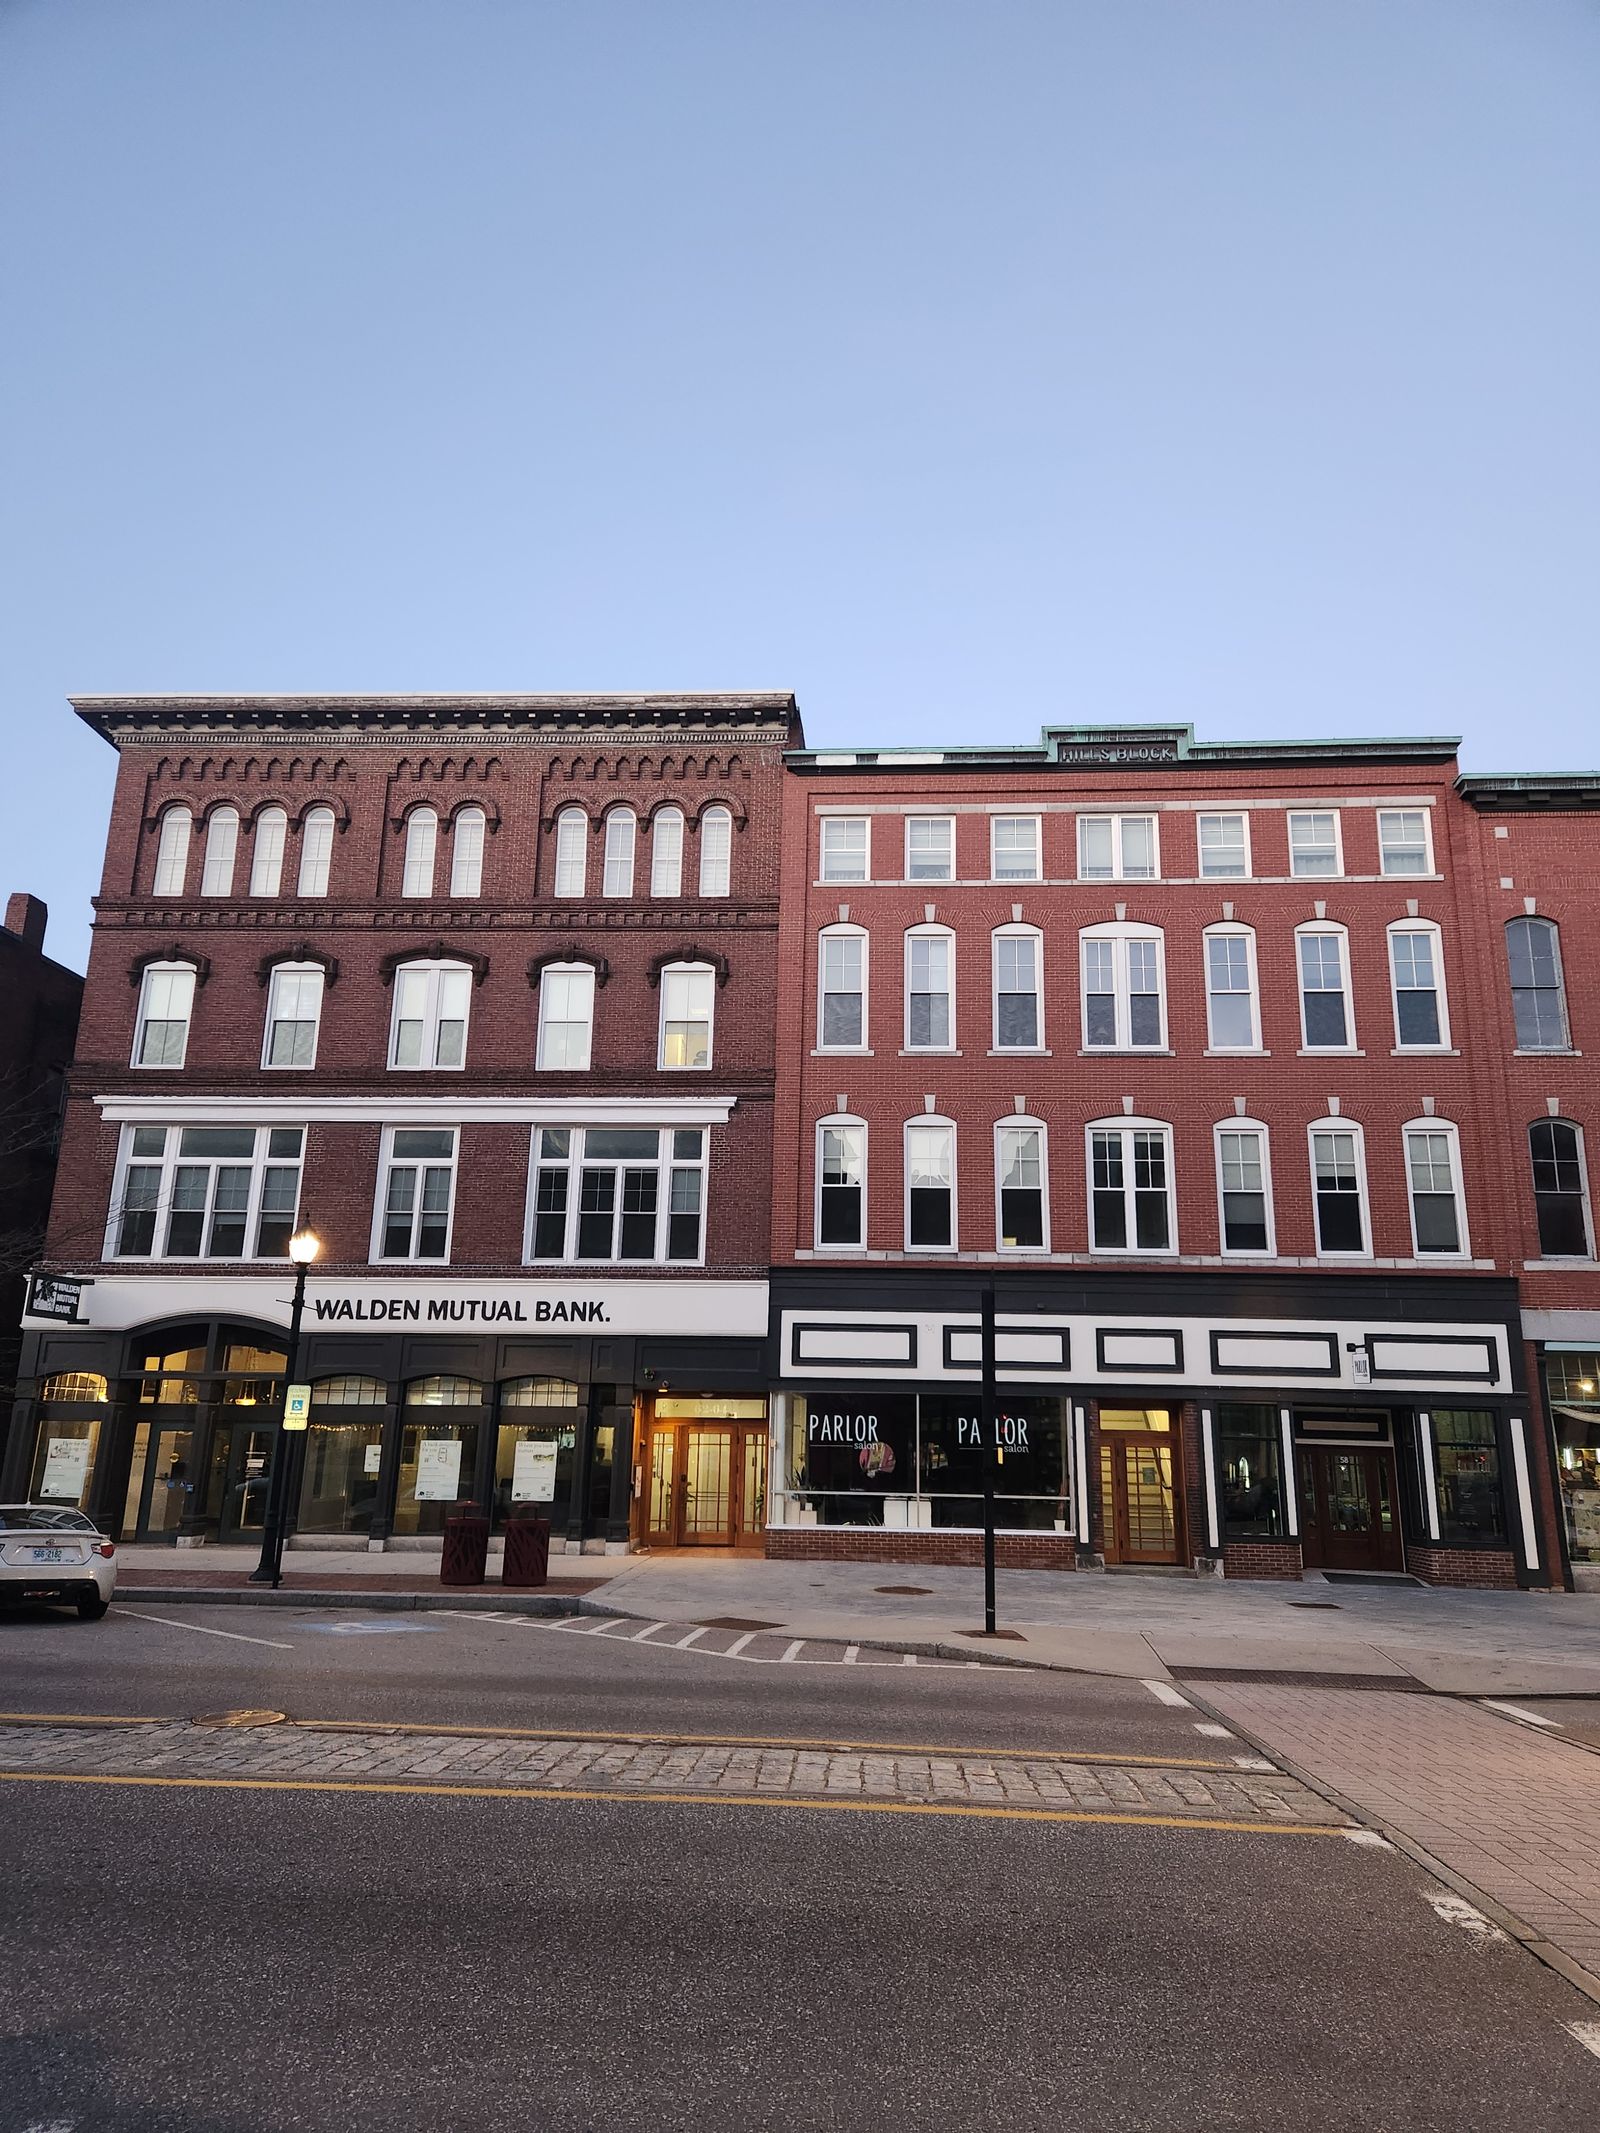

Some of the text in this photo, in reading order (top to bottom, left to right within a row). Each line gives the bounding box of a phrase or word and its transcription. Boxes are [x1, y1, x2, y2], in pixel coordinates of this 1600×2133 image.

[1116, 746, 1172, 760] BLOCK
[316, 1299, 611, 1323] WALDEN MUTUAL BANK.
[809, 1414, 879, 1441] PARLOR
[958, 1417, 1029, 1445] PALOR
[853, 1441, 879, 1450] salon
[1003, 1443, 1029, 1453] salon
